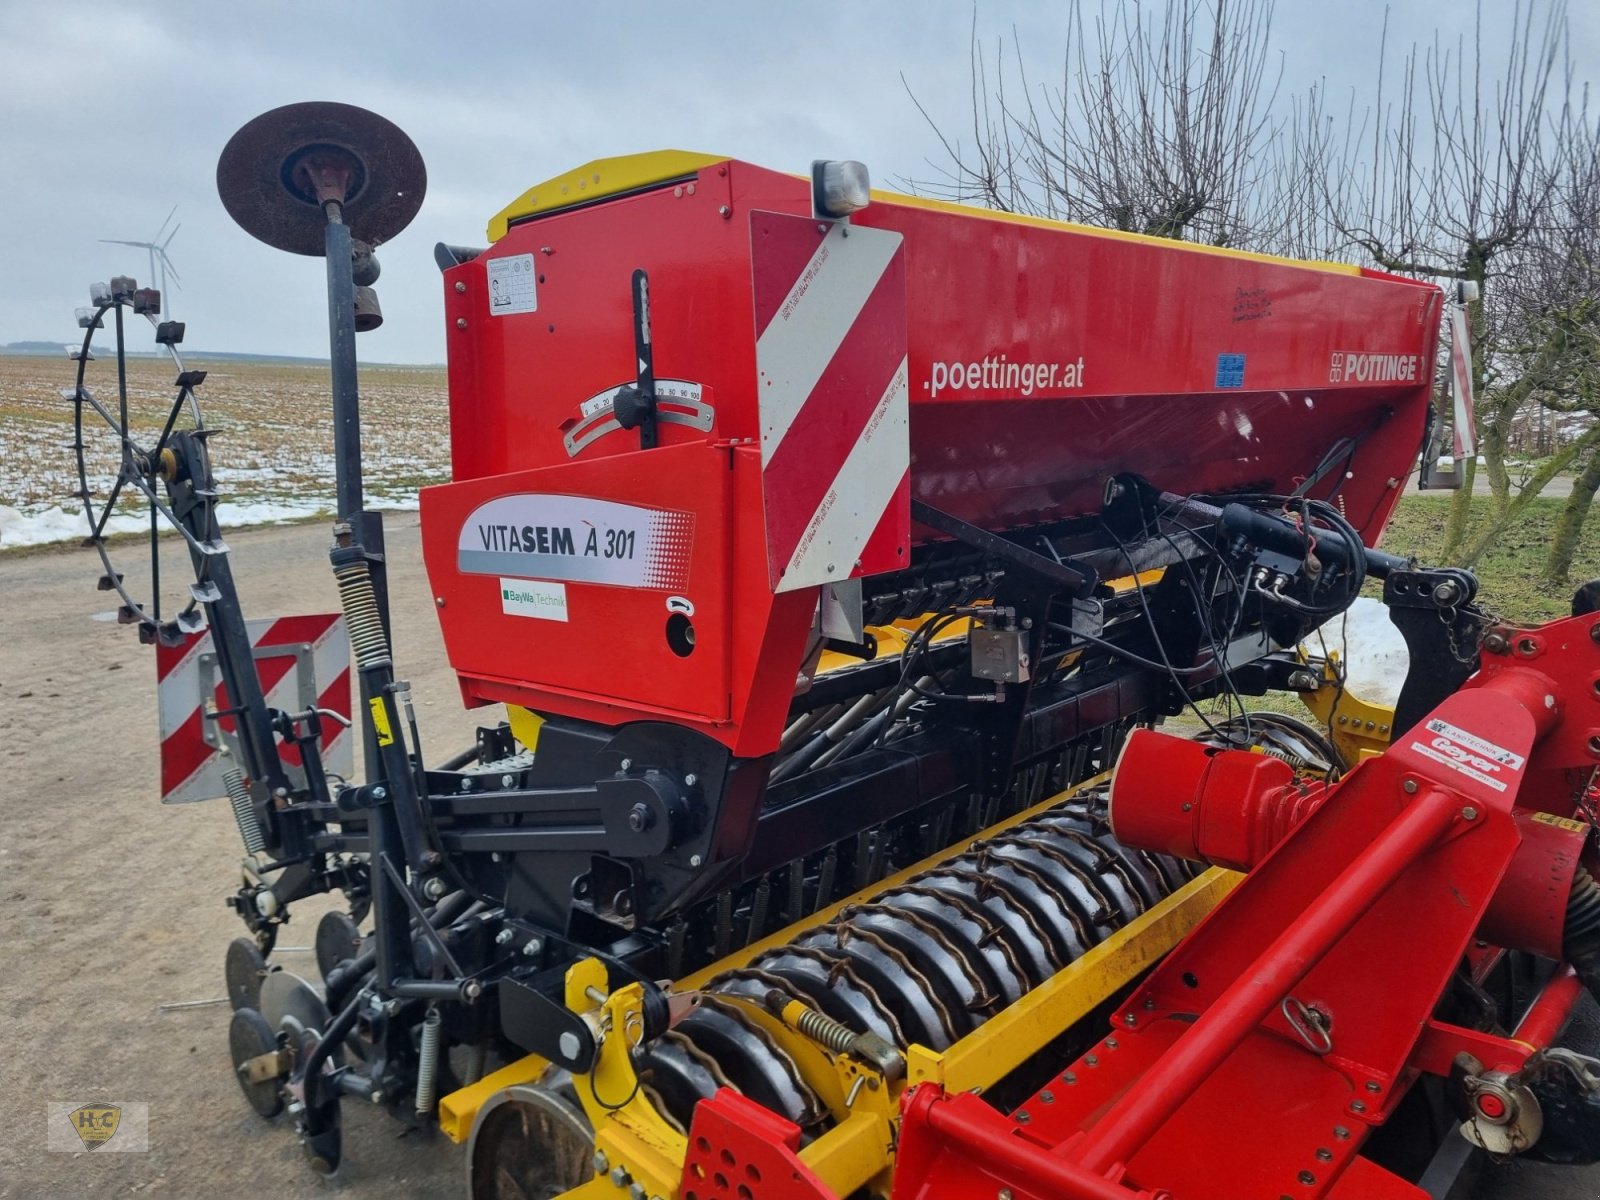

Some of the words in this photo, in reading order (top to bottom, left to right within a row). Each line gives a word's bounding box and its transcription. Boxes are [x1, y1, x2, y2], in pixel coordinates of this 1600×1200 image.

[923, 354, 1085, 398] .poettinger.at
[602, 397, 610, 406] 20
[690, 391, 700, 400] 100
[478, 525, 576, 556] VITASEM
[584, 527, 598, 557] A
[604, 528, 636, 560] 301
[509, 590, 534, 604] BayWa
[536, 592, 566, 608] Technik
[1431, 737, 1501, 772] Geyer
[1446, 729, 1498, 756] LANDTECHNIK
